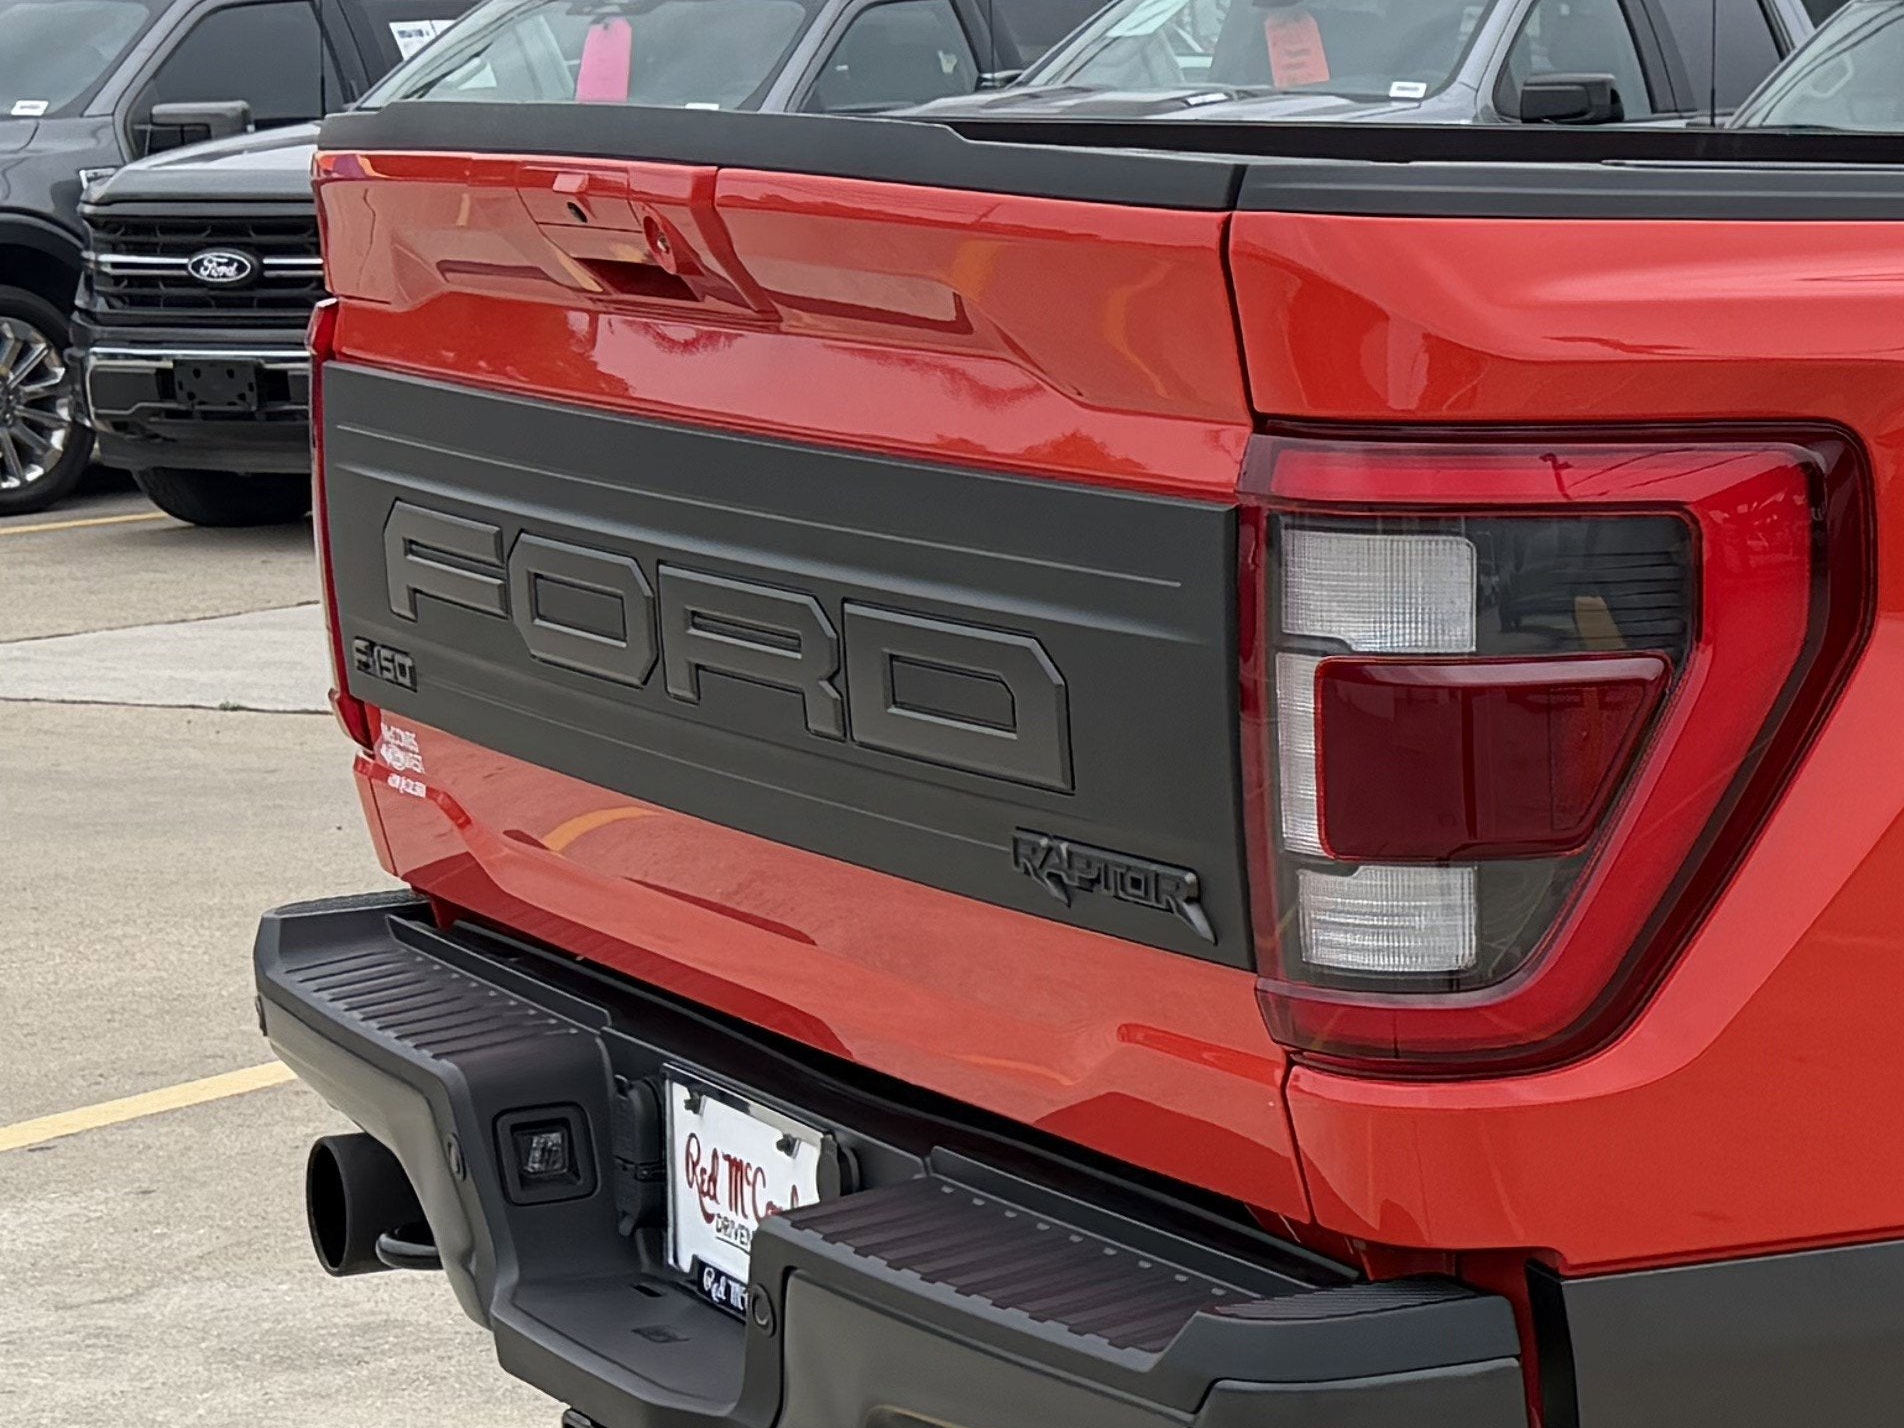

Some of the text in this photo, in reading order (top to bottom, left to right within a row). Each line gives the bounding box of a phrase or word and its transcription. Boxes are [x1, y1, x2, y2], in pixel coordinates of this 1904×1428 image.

[200, 255, 239, 278] Ford
[383, 498, 1076, 797] FORD
[1012, 826, 1218, 947] RAPTOR
[685, 1132, 799, 1224] Red McCo
[703, 1267, 727, 1304] Red
